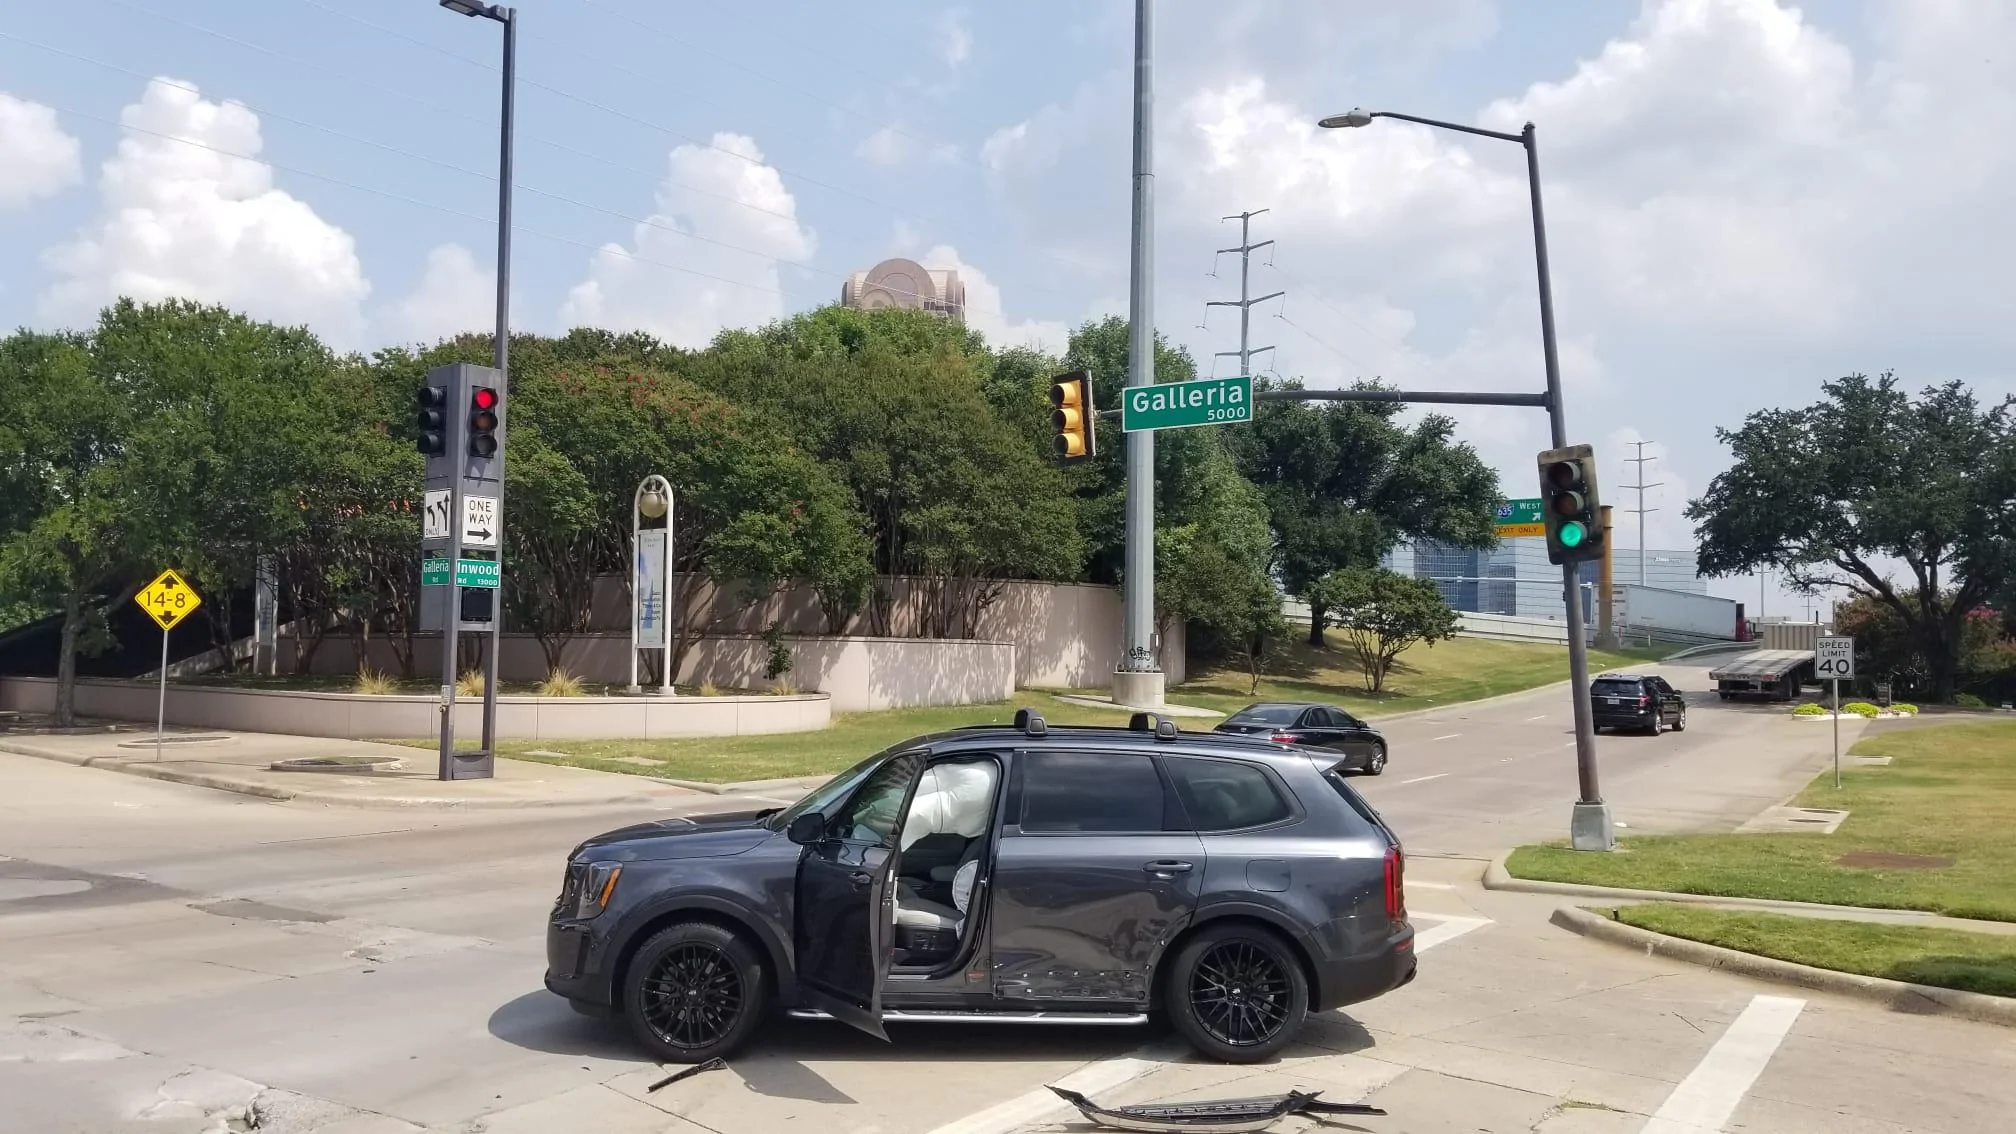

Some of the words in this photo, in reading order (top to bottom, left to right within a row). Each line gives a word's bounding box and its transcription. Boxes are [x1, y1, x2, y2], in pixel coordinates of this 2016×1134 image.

[1132, 382, 1244, 413] Galleria
[1207, 406, 1246, 420] 5000
[469, 499, 492, 513] ONE
[1497, 507, 1512, 516] 635
[469, 512, 493, 525] WAY
[423, 560, 449, 573] Galleria
[457, 562, 499, 576] Inwood
[1818, 641, 1850, 649] SPEED
[1818, 659, 1850, 674] 40
